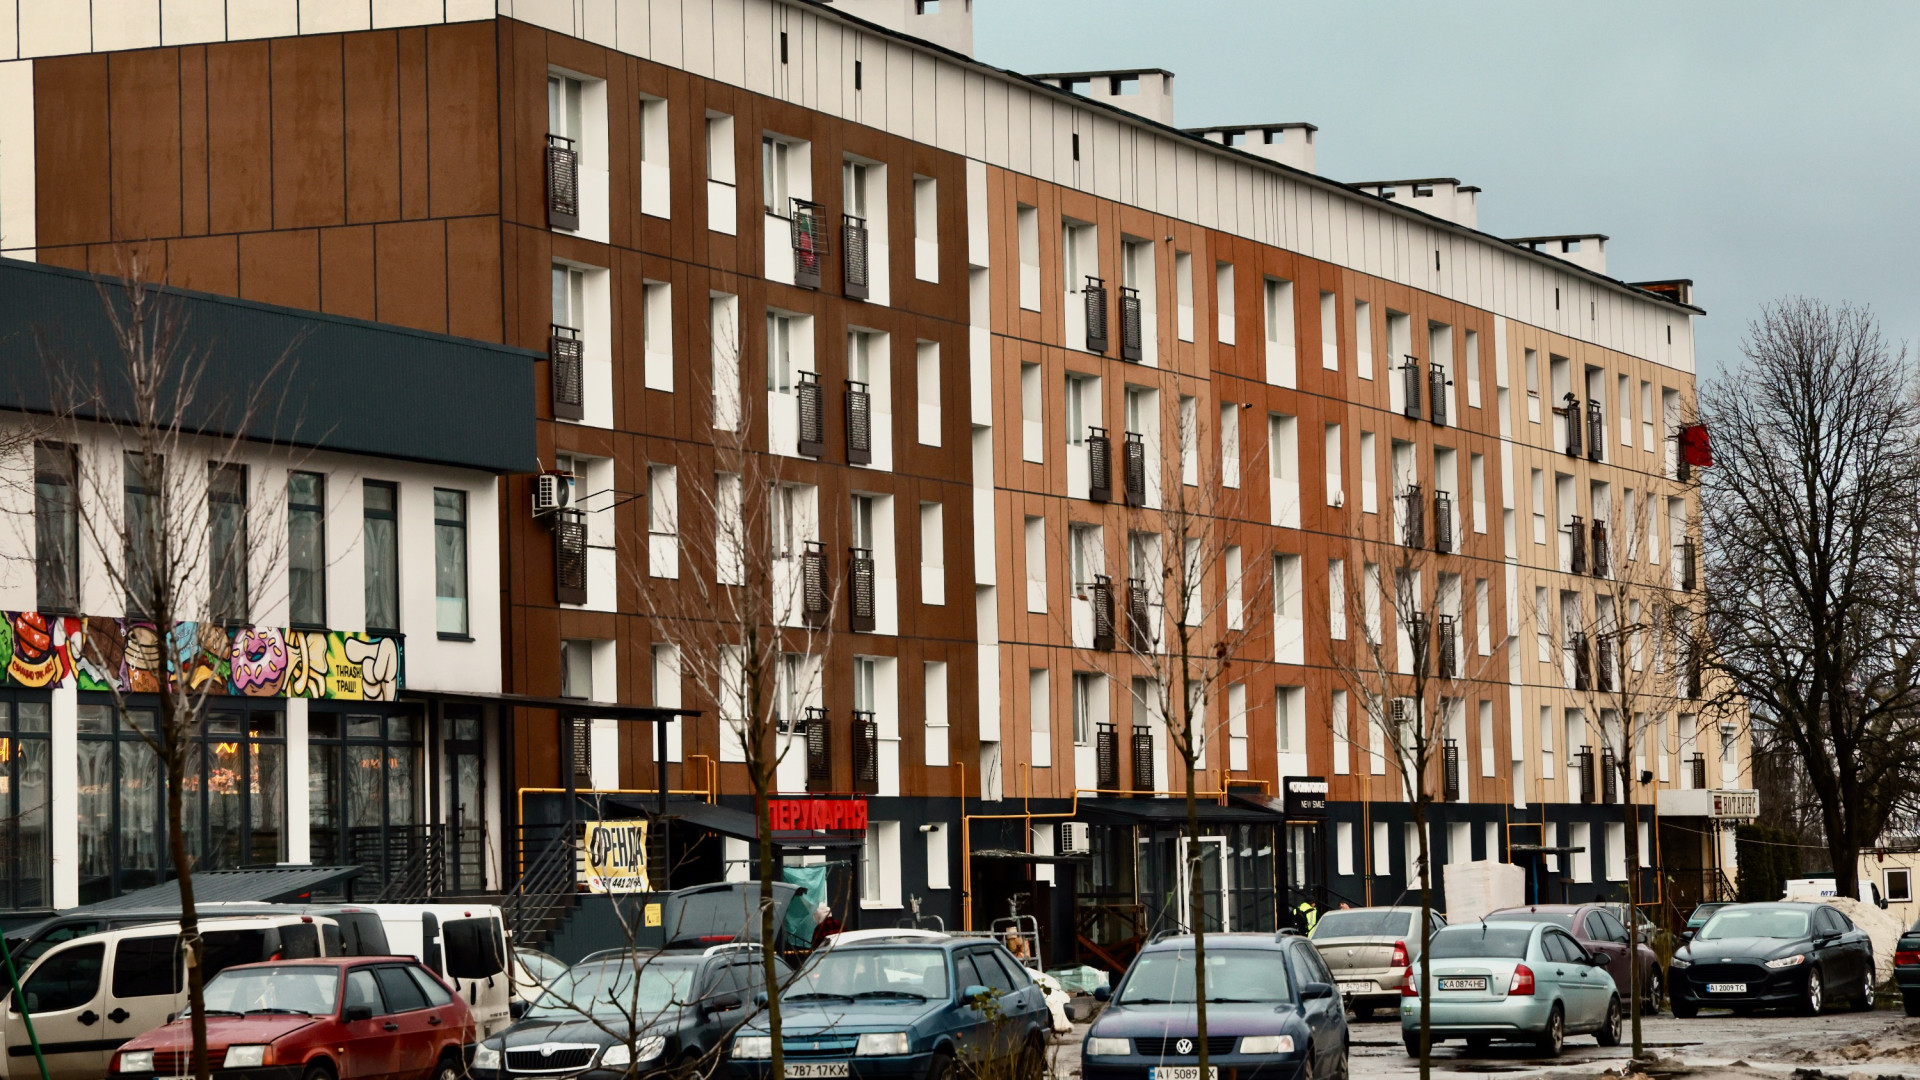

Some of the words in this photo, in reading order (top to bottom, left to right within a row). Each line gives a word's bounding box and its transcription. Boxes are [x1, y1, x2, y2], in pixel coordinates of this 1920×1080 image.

[336, 680, 356, 693] ТРАШ!
[1723, 796, 1756, 814] НОТАРІУС
[768, 799, 867, 830] ПЕРУКАРНЯ
[590, 826, 644, 873] ОРЕНДА
[1174, 1069, 1198, 1080] 5089
